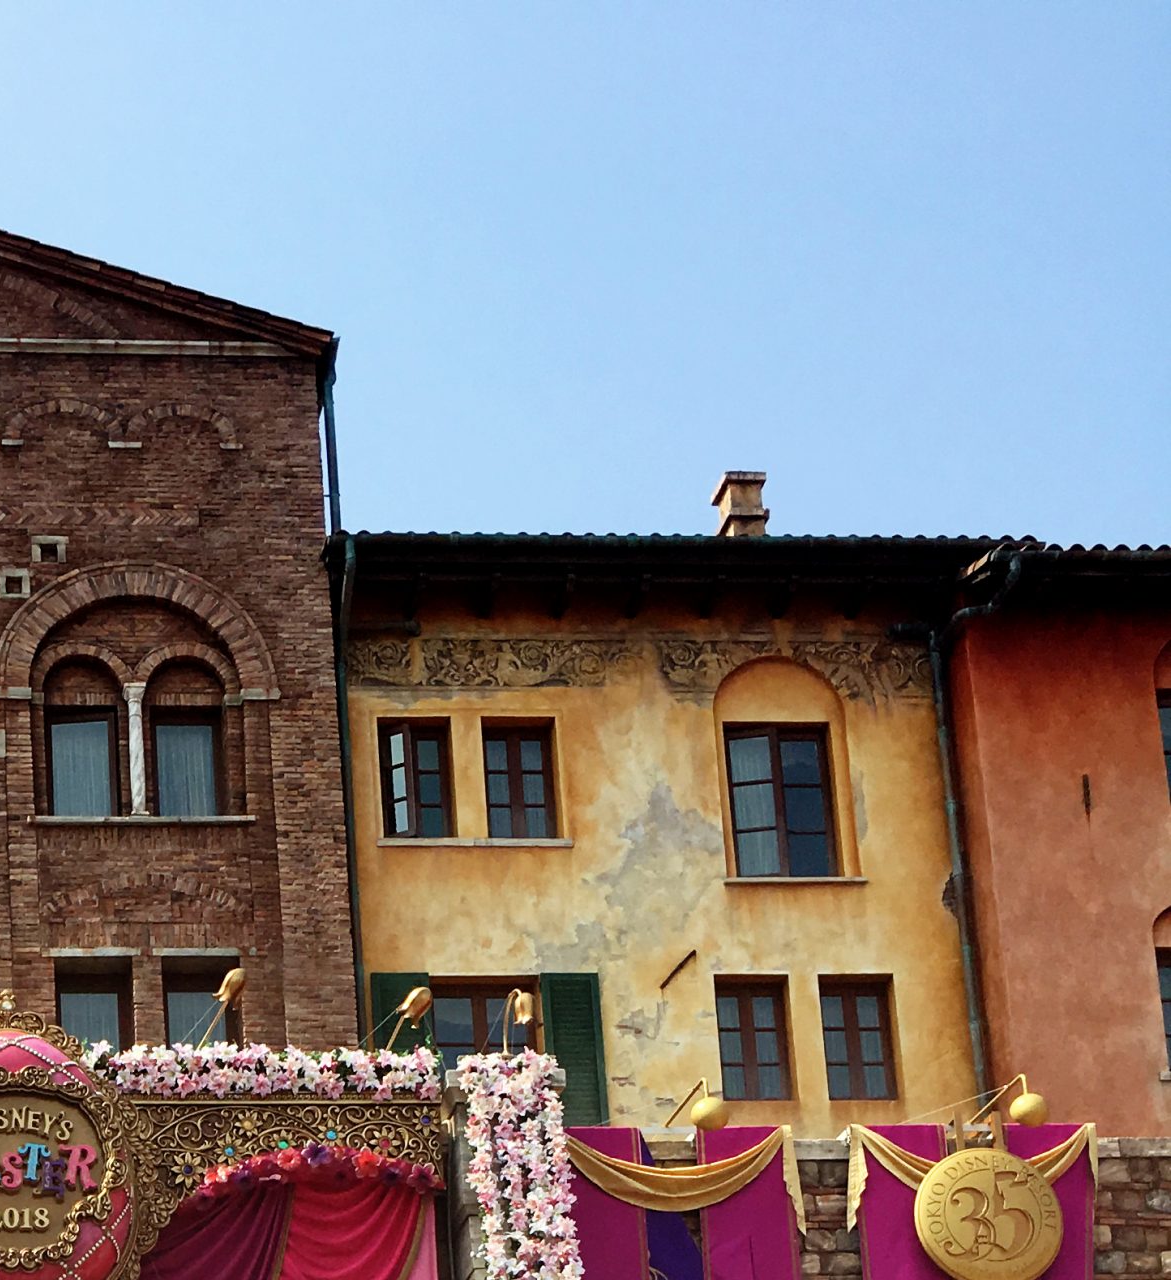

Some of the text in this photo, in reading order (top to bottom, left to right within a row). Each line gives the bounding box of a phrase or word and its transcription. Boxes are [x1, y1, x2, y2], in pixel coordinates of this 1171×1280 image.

[926, 1155, 1057, 1248] TOKYO DISNEY RESORT
[943, 1170, 1034, 1262] 35
